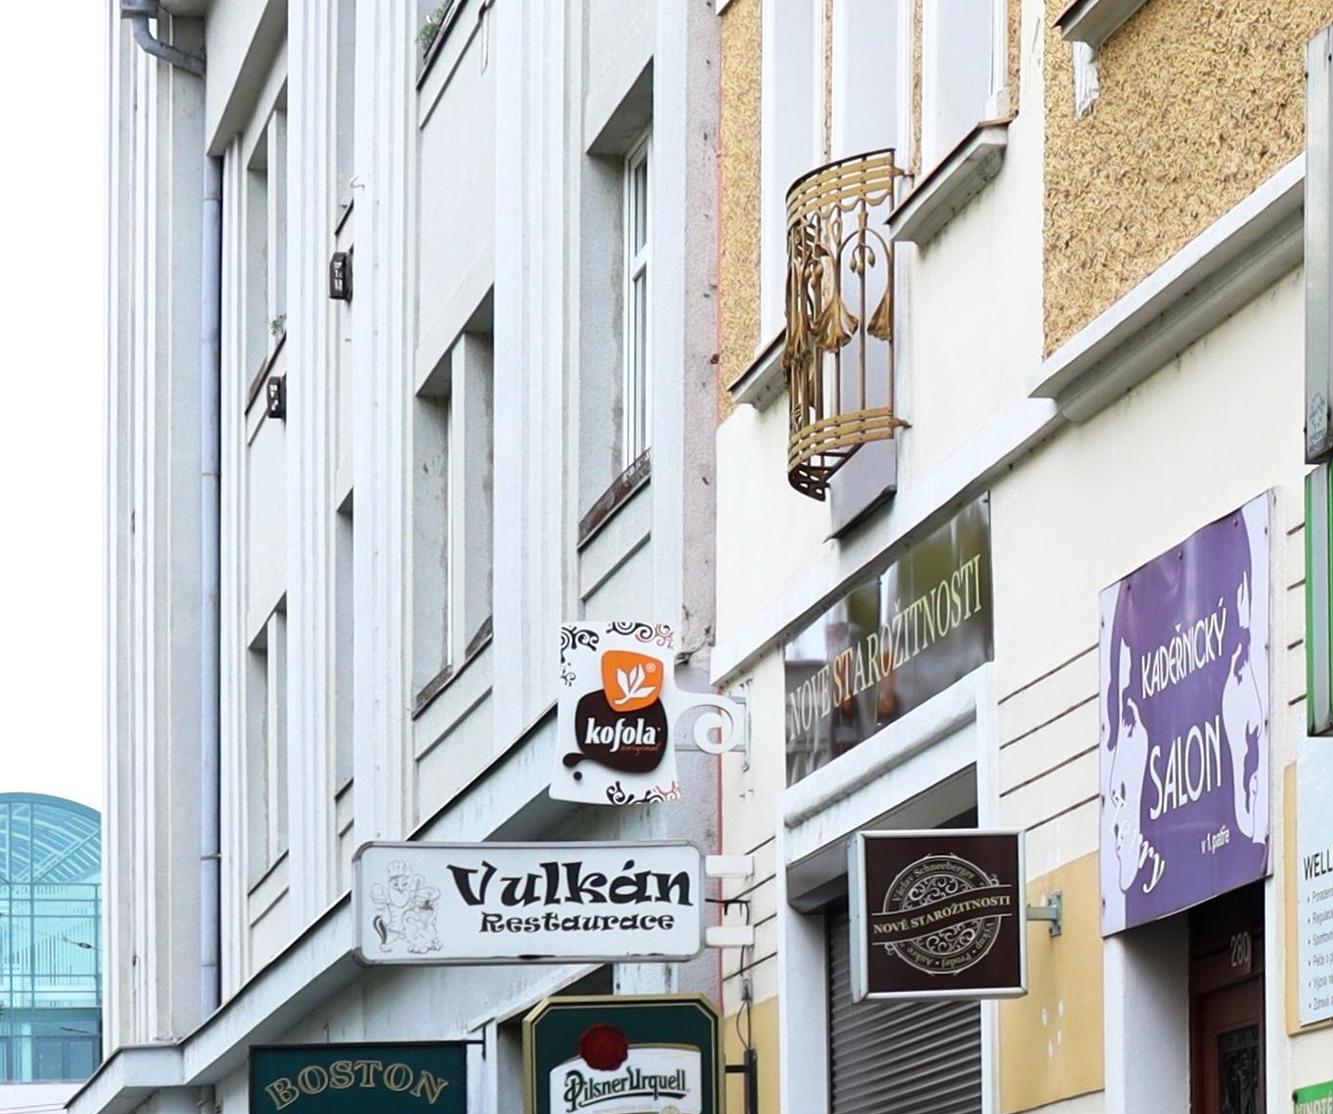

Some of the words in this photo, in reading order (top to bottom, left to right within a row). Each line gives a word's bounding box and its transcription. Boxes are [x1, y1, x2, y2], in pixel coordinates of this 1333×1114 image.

[832, 555, 983, 708] STAROŽITNOSTI
[1140, 596, 1229, 700] KADEŘNICKÝ
[584, 717, 657, 752] kofola
[1149, 714, 1224, 821] SALON
[446, 858, 695, 908] Vulkán
[479, 911, 675, 934] Restaurace
[873, 916, 910, 935] NOVÉ
[910, 895, 1011, 927] STAROŽITNOSTI
[1230, 930, 1251, 968] 280
[265, 1060, 449, 1111] BOSTON
[563, 1069, 629, 1113] Pilsner
[626, 1066, 687, 1101] Urquell
